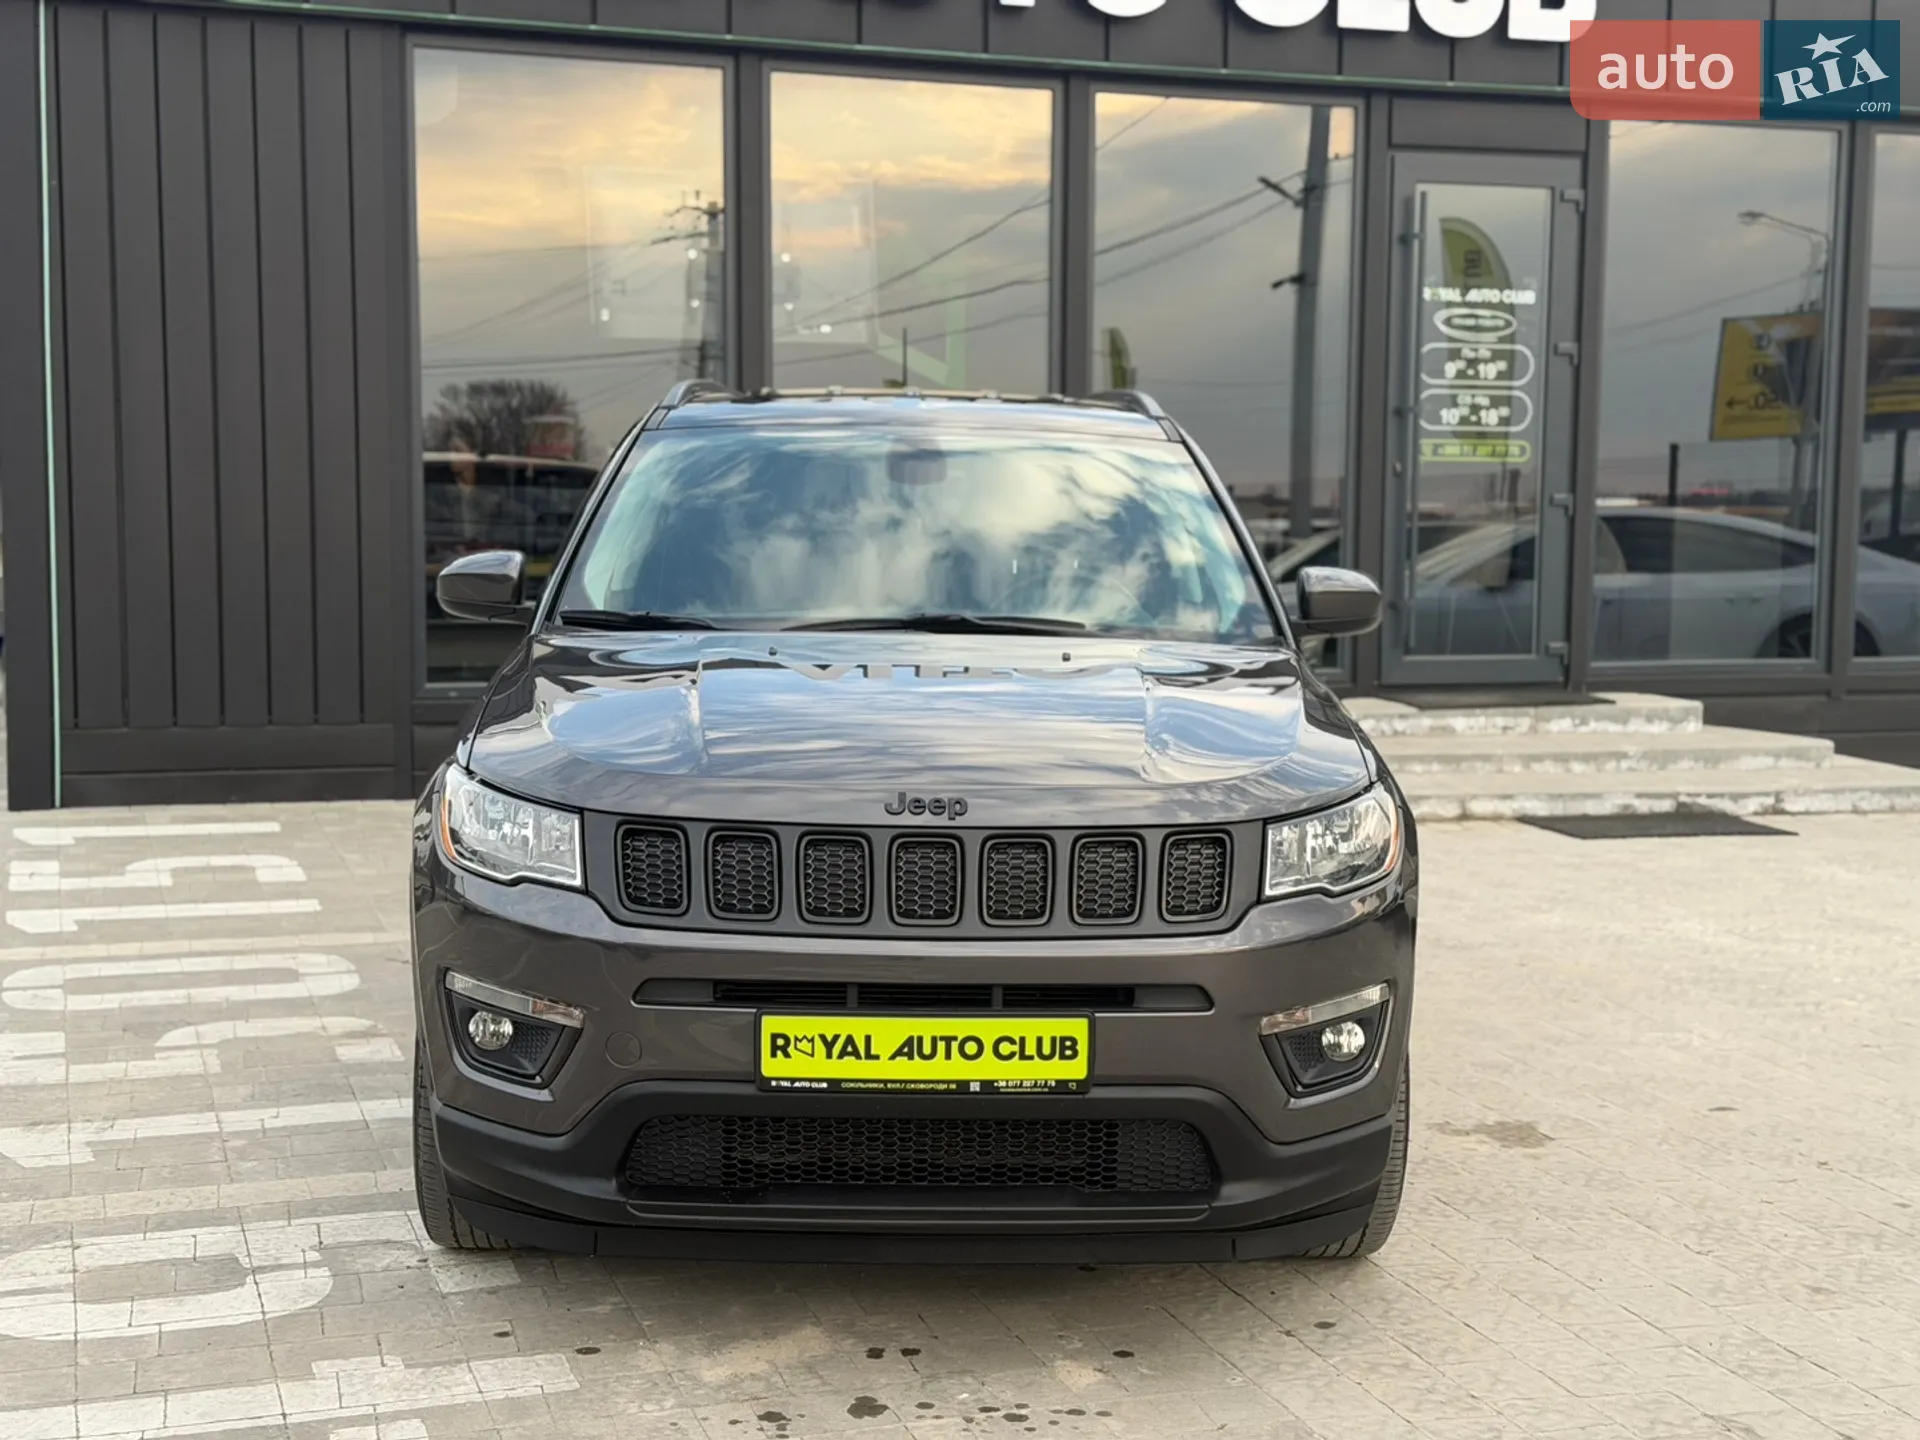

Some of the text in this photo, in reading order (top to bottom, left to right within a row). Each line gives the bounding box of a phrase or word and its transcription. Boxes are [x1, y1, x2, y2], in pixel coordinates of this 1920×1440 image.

[884, 792, 968, 821] Jeep
[888, 1033, 985, 1062] AUTO
[992, 1035, 1079, 1062] CLUB
